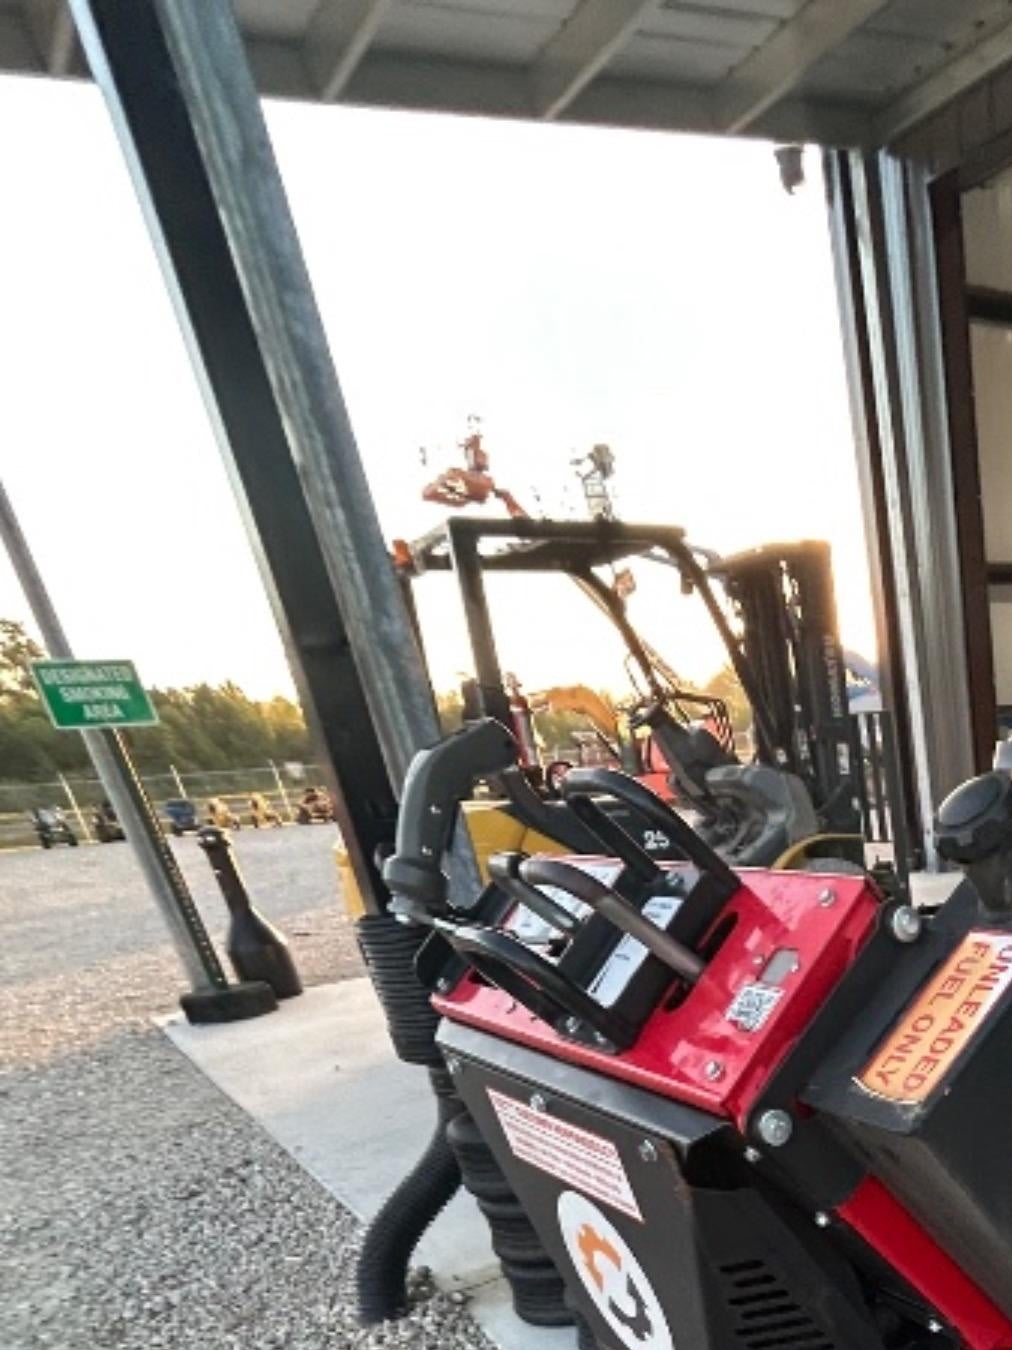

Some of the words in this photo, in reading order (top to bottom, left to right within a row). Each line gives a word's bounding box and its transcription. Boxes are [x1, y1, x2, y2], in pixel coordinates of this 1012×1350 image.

[83, 703, 125, 721] AREA
[929, 941, 991, 1005] FUEL
[875, 1013, 935, 1088] ONLY
